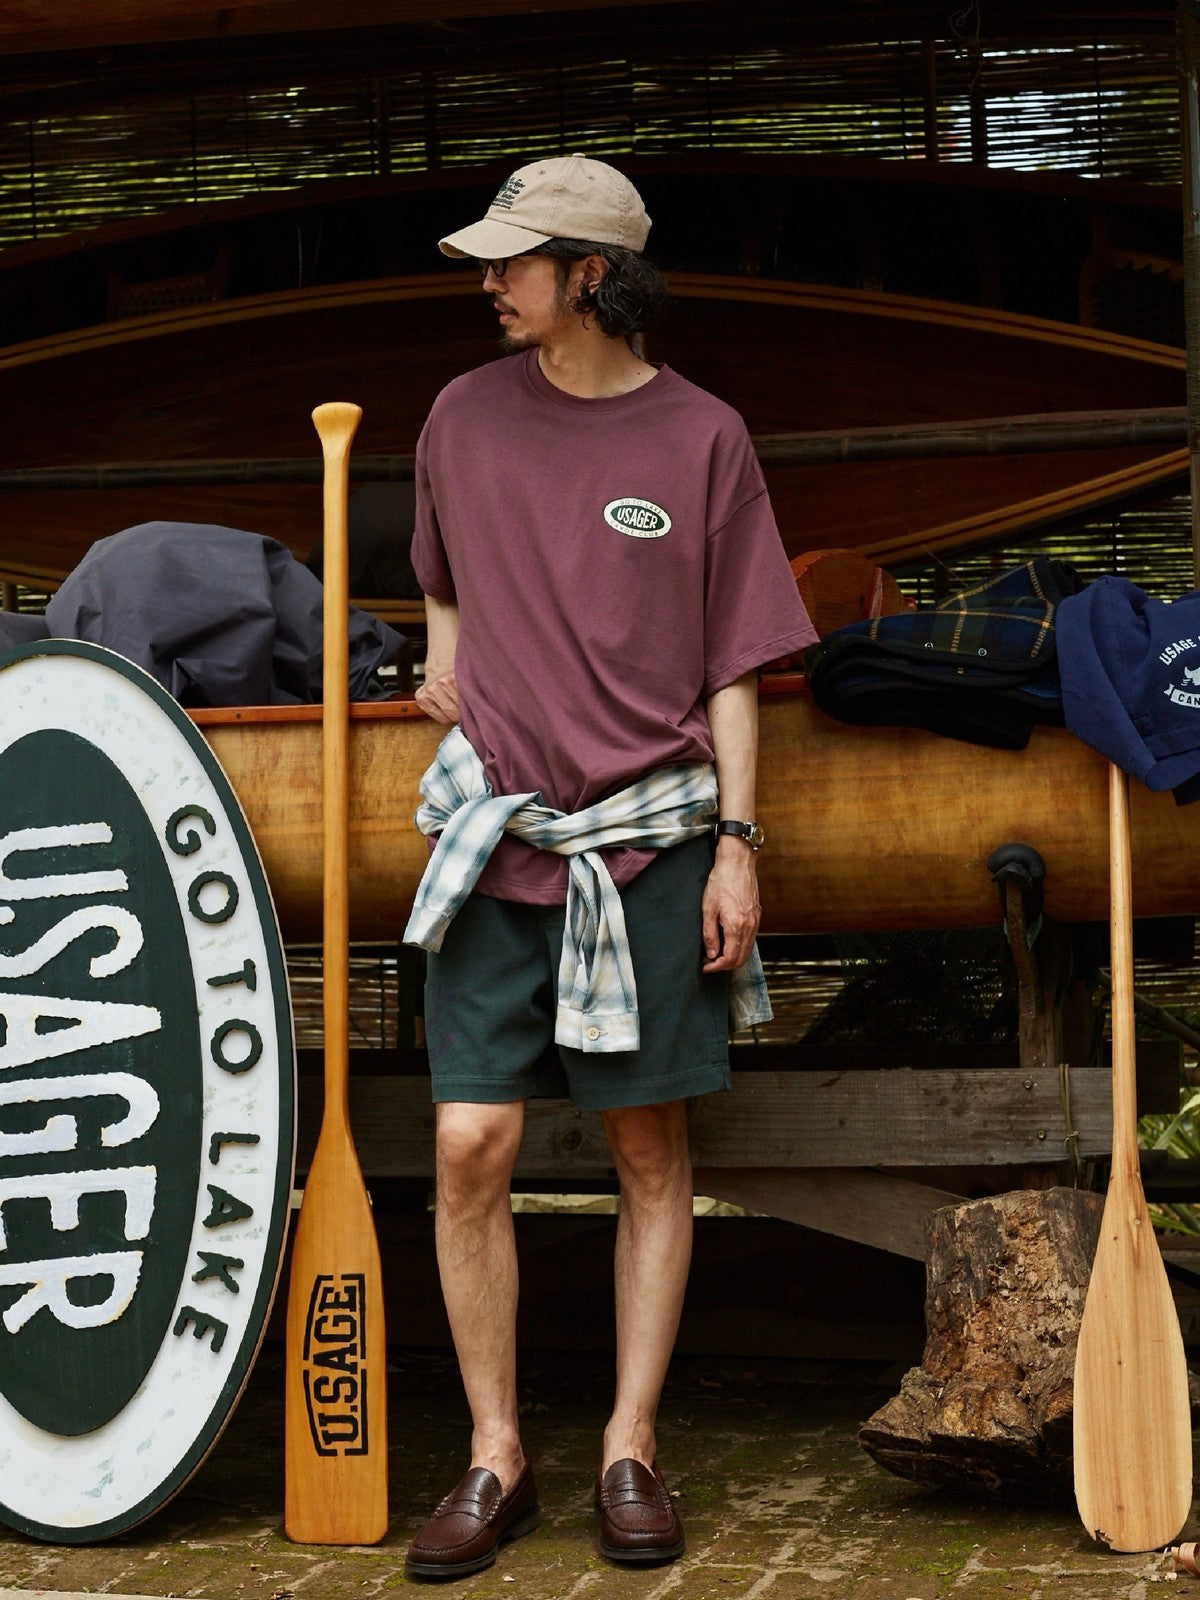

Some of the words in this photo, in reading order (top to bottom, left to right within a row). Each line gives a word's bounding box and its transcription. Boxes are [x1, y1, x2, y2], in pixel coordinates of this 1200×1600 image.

[616, 507, 658, 529] USAGER
[1159, 638, 1198, 666] USAGE
[165, 803, 239, 925] GO
[206, 957, 264, 1075] TO
[0, 822, 162, 1334] USAGER
[172, 1132, 261, 1354] LAKE
